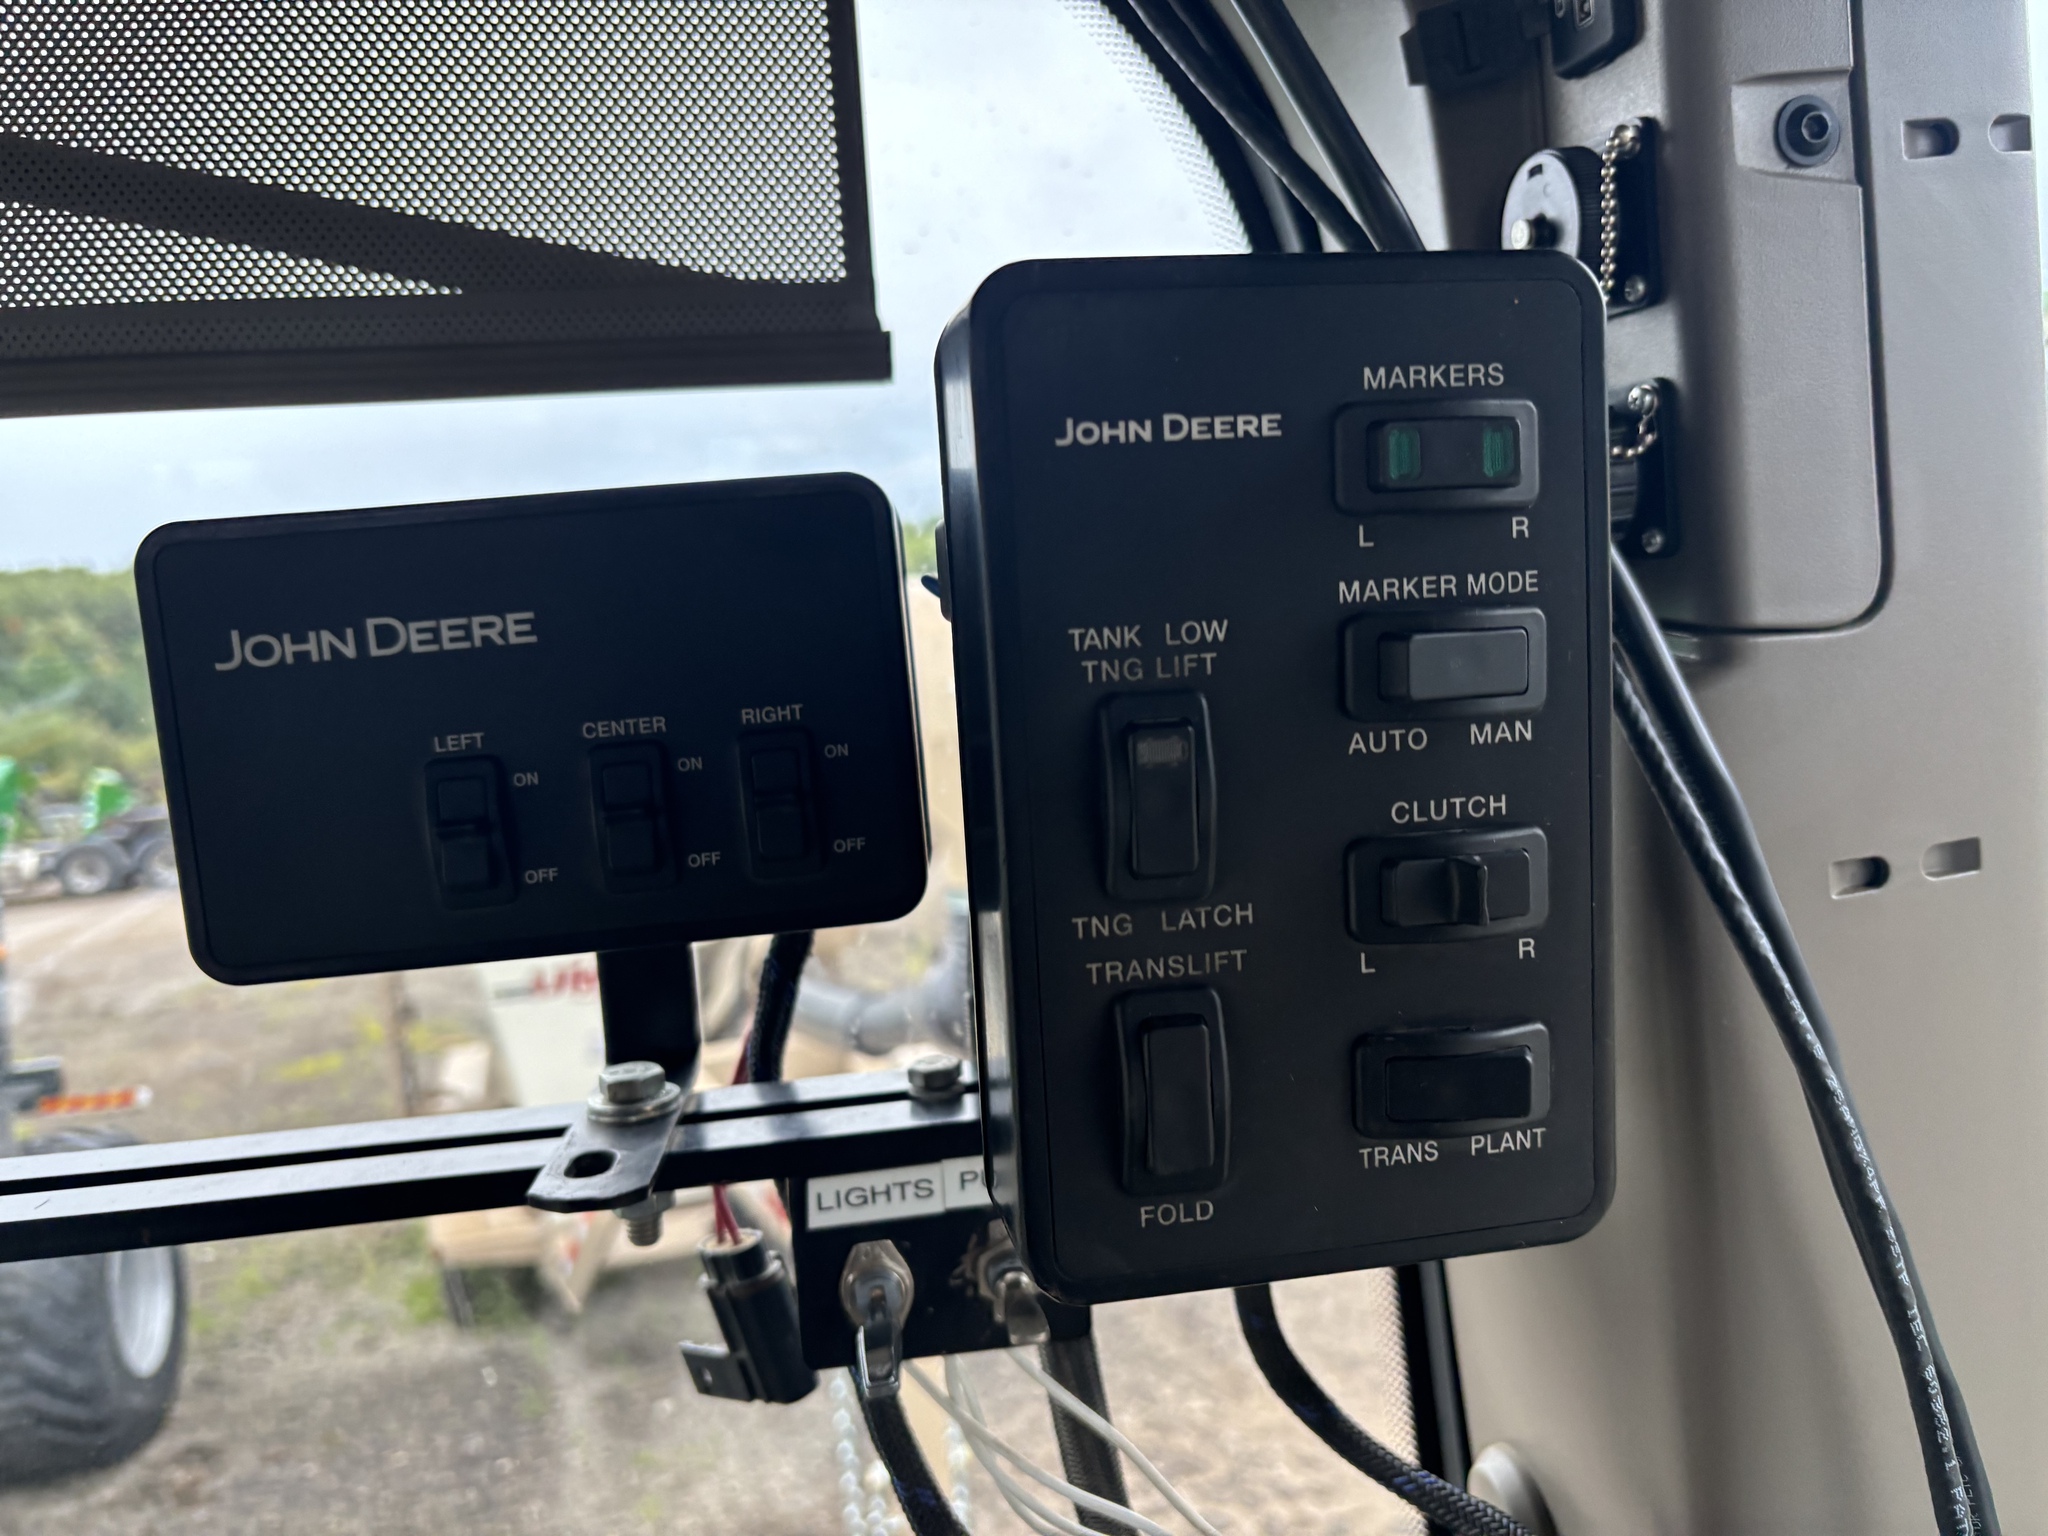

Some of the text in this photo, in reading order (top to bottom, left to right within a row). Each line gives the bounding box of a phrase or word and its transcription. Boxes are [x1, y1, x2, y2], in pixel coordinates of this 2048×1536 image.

[1363, 362, 1506, 391] MARKERS
[1055, 412, 1283, 448] JOHN DEERE
[1358, 523, 1375, 548] L
[1511, 516, 1530, 540] R
[1338, 569, 1540, 604] MARKER MODE
[212, 609, 538, 673] JOHN DEERE
[1068, 617, 1229, 654] TANK LOW
[1081, 651, 1218, 684] TNG LIFT
[581, 715, 667, 740] CENTER
[740, 703, 803, 724] RIGHT
[432, 732, 484, 753] LEFT
[1347, 726, 1429, 756] AUTO
[1469, 718, 1534, 746] MAN
[676, 755, 704, 772] ON
[823, 742, 850, 759] ON
[512, 770, 540, 787] ON
[1390, 793, 1508, 825] CLUTCH
[832, 836, 867, 854] OFF
[686, 851, 722, 869] OFF
[524, 866, 559, 885] OFF
[1071, 903, 1255, 940] TNG LATCH
[1517, 937, 1536, 960] R
[1085, 949, 1248, 986] TRANSLIFT
[1359, 952, 1376, 974] L
[1358, 1127, 1547, 1170] TRANS PLANT
[816, 1177, 936, 1212] LIGHTS
[1139, 1199, 1215, 1229] FOLD
